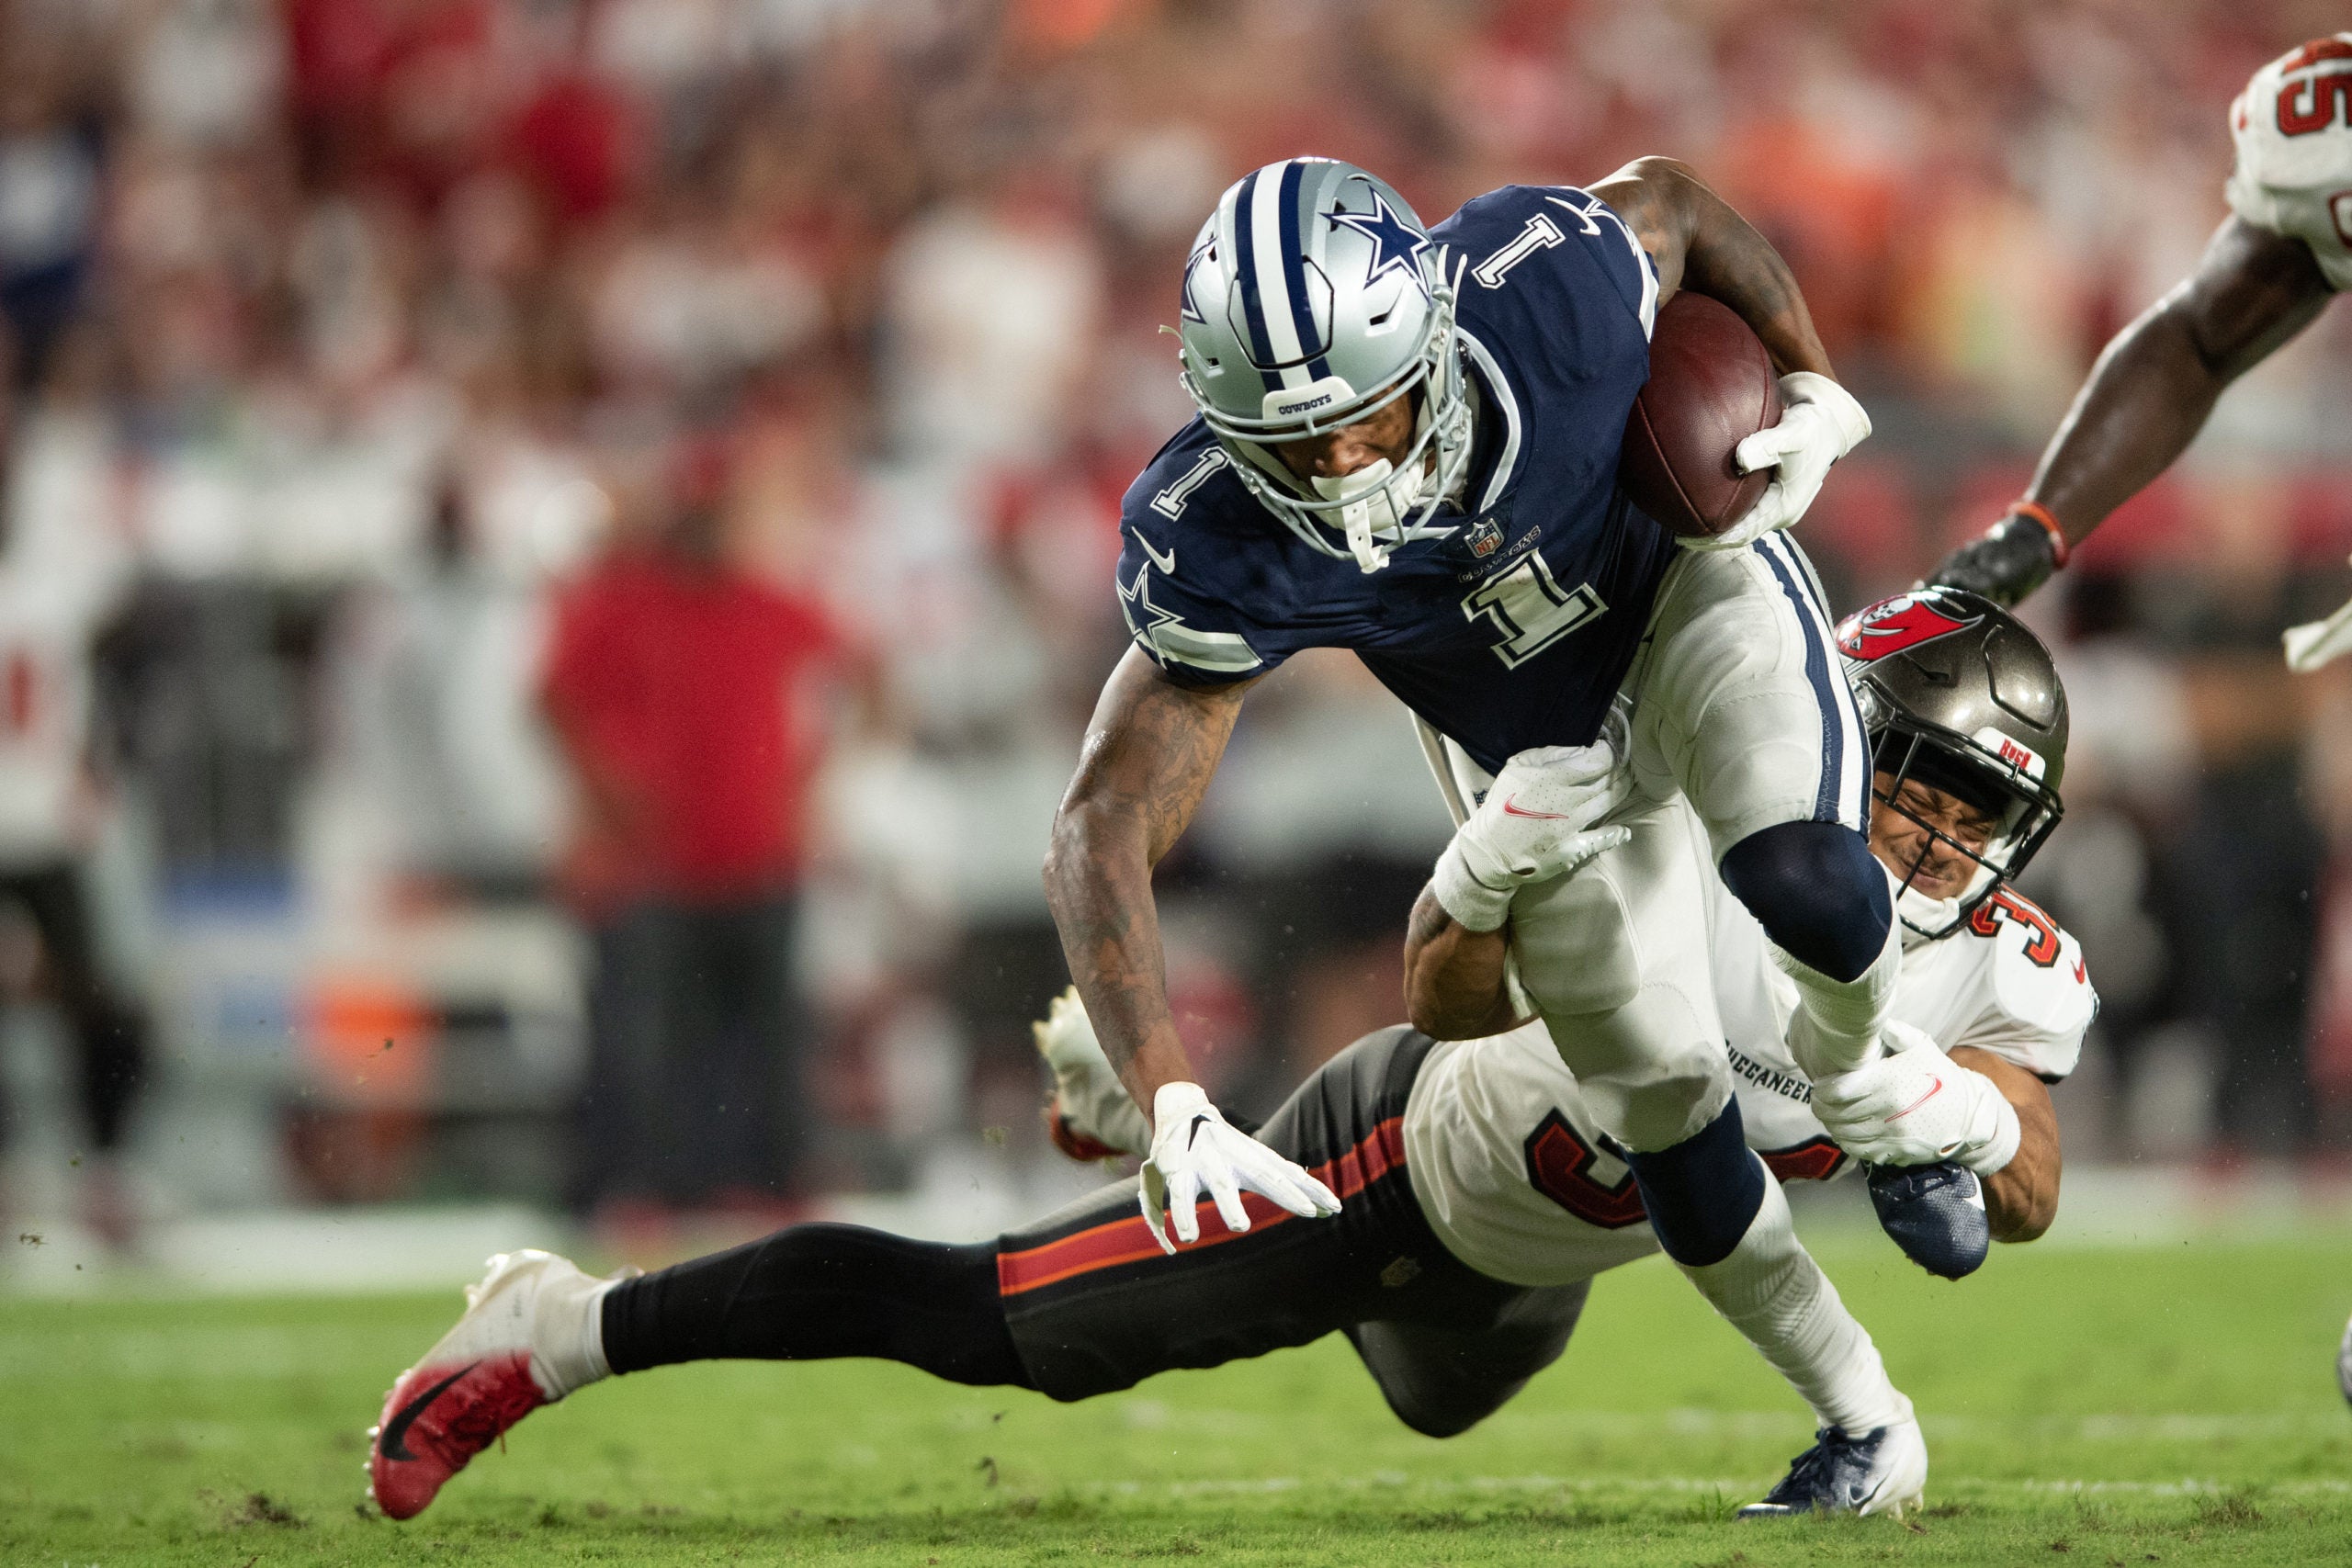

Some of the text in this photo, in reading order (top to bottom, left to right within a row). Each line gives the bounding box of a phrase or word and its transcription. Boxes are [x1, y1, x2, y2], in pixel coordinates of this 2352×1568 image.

[1471, 212, 1566, 289] 1
[1278, 394, 1332, 415] COWBOYS
[1149, 446, 1230, 522] 1
[1458, 525, 1542, 582] COOYS
[1476, 535, 1499, 556] NFL
[1460, 547, 1609, 671] 1
[1967, 882, 2061, 967] 3
[1725, 1038, 1814, 1104] UCCANEER
